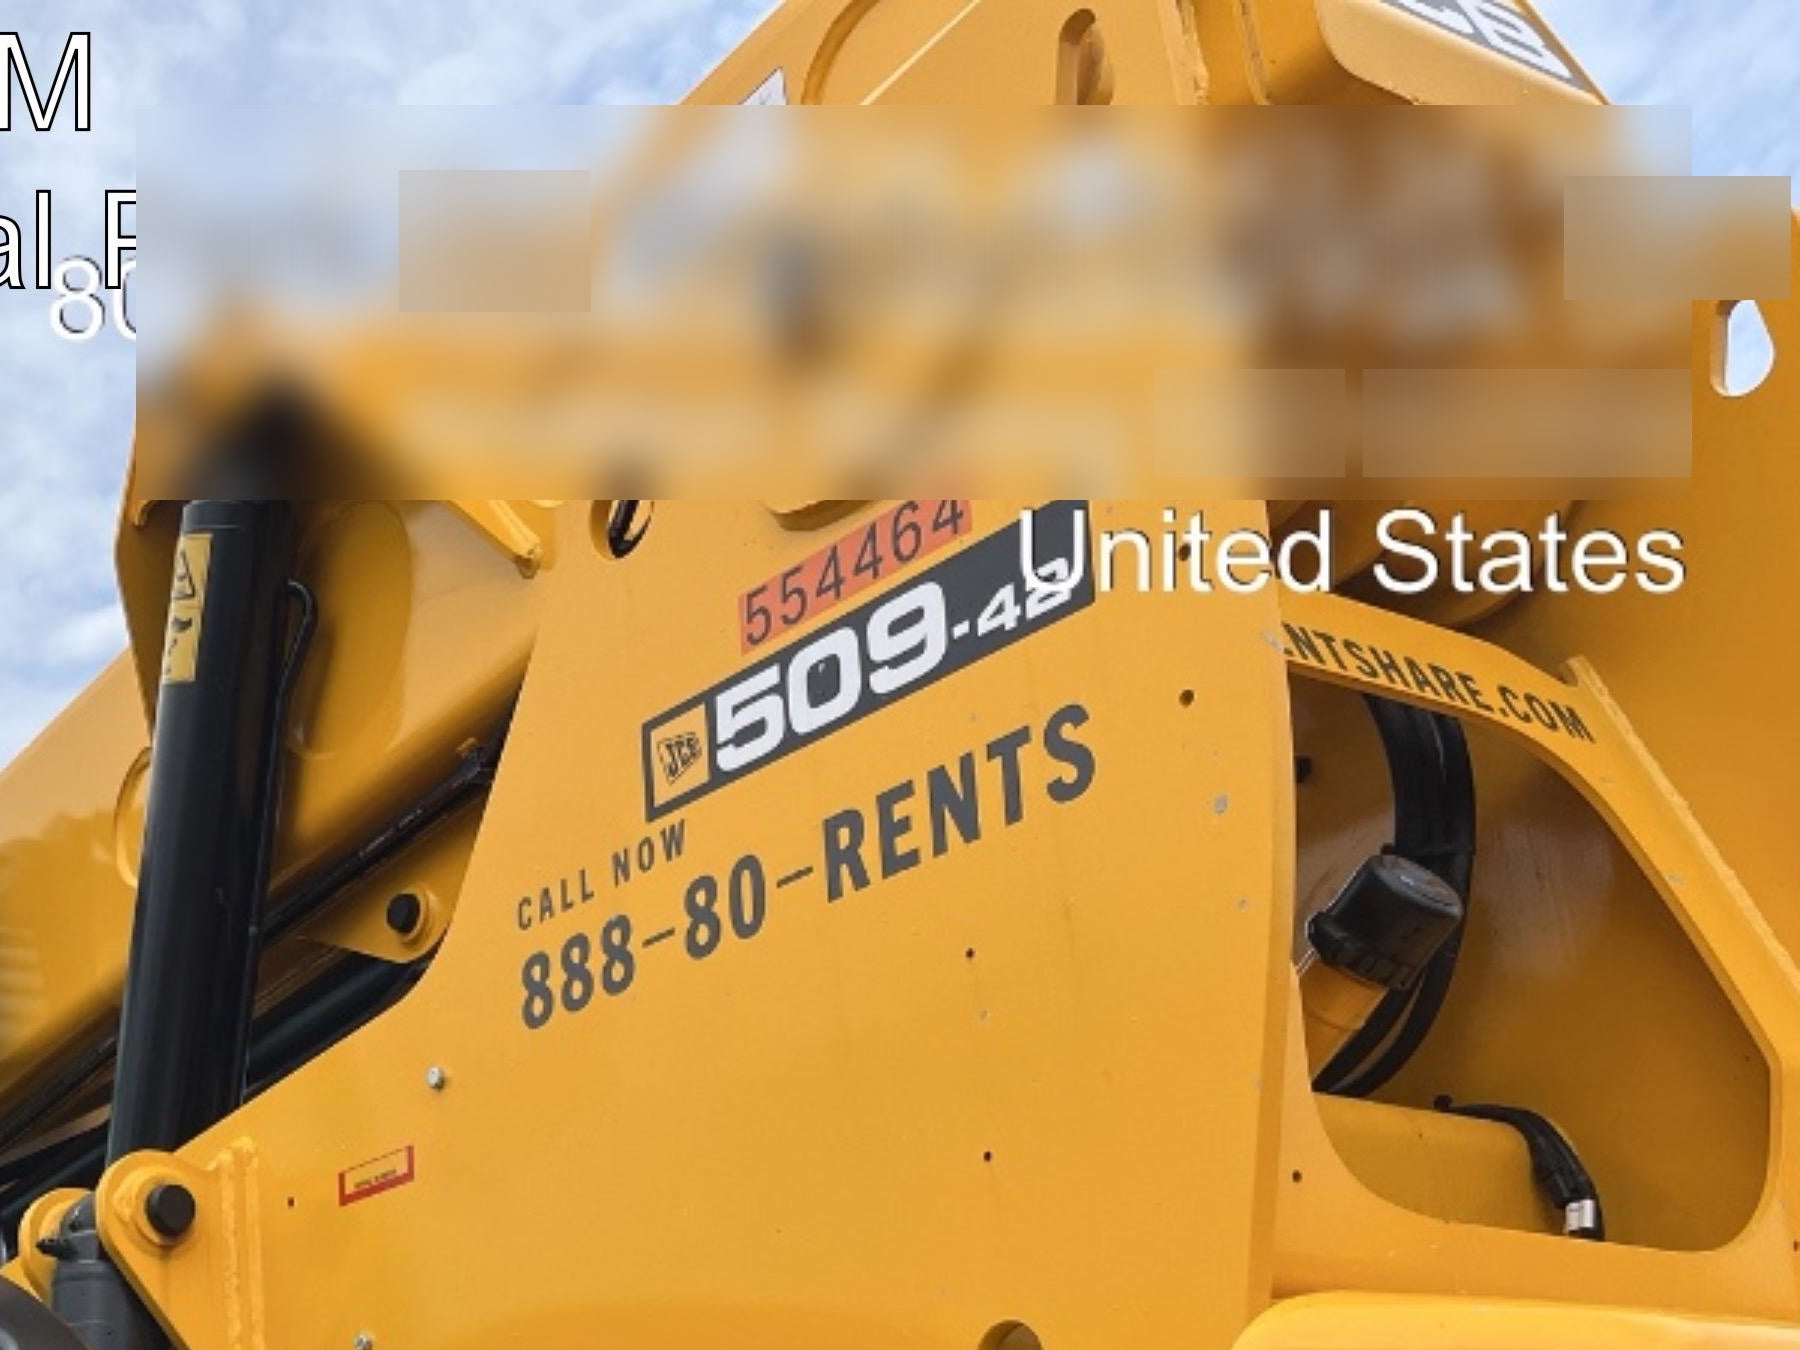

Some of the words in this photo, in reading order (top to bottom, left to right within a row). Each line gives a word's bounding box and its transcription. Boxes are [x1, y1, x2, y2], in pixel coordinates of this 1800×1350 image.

[745, 500, 964, 646] 554464
[1283, 620, 1597, 744] NTSHARE.COM
[517, 868, 595, 930] CALL
[612, 819, 687, 887] NOW
[520, 703, 1097, 1030] 888-80-RENTS
